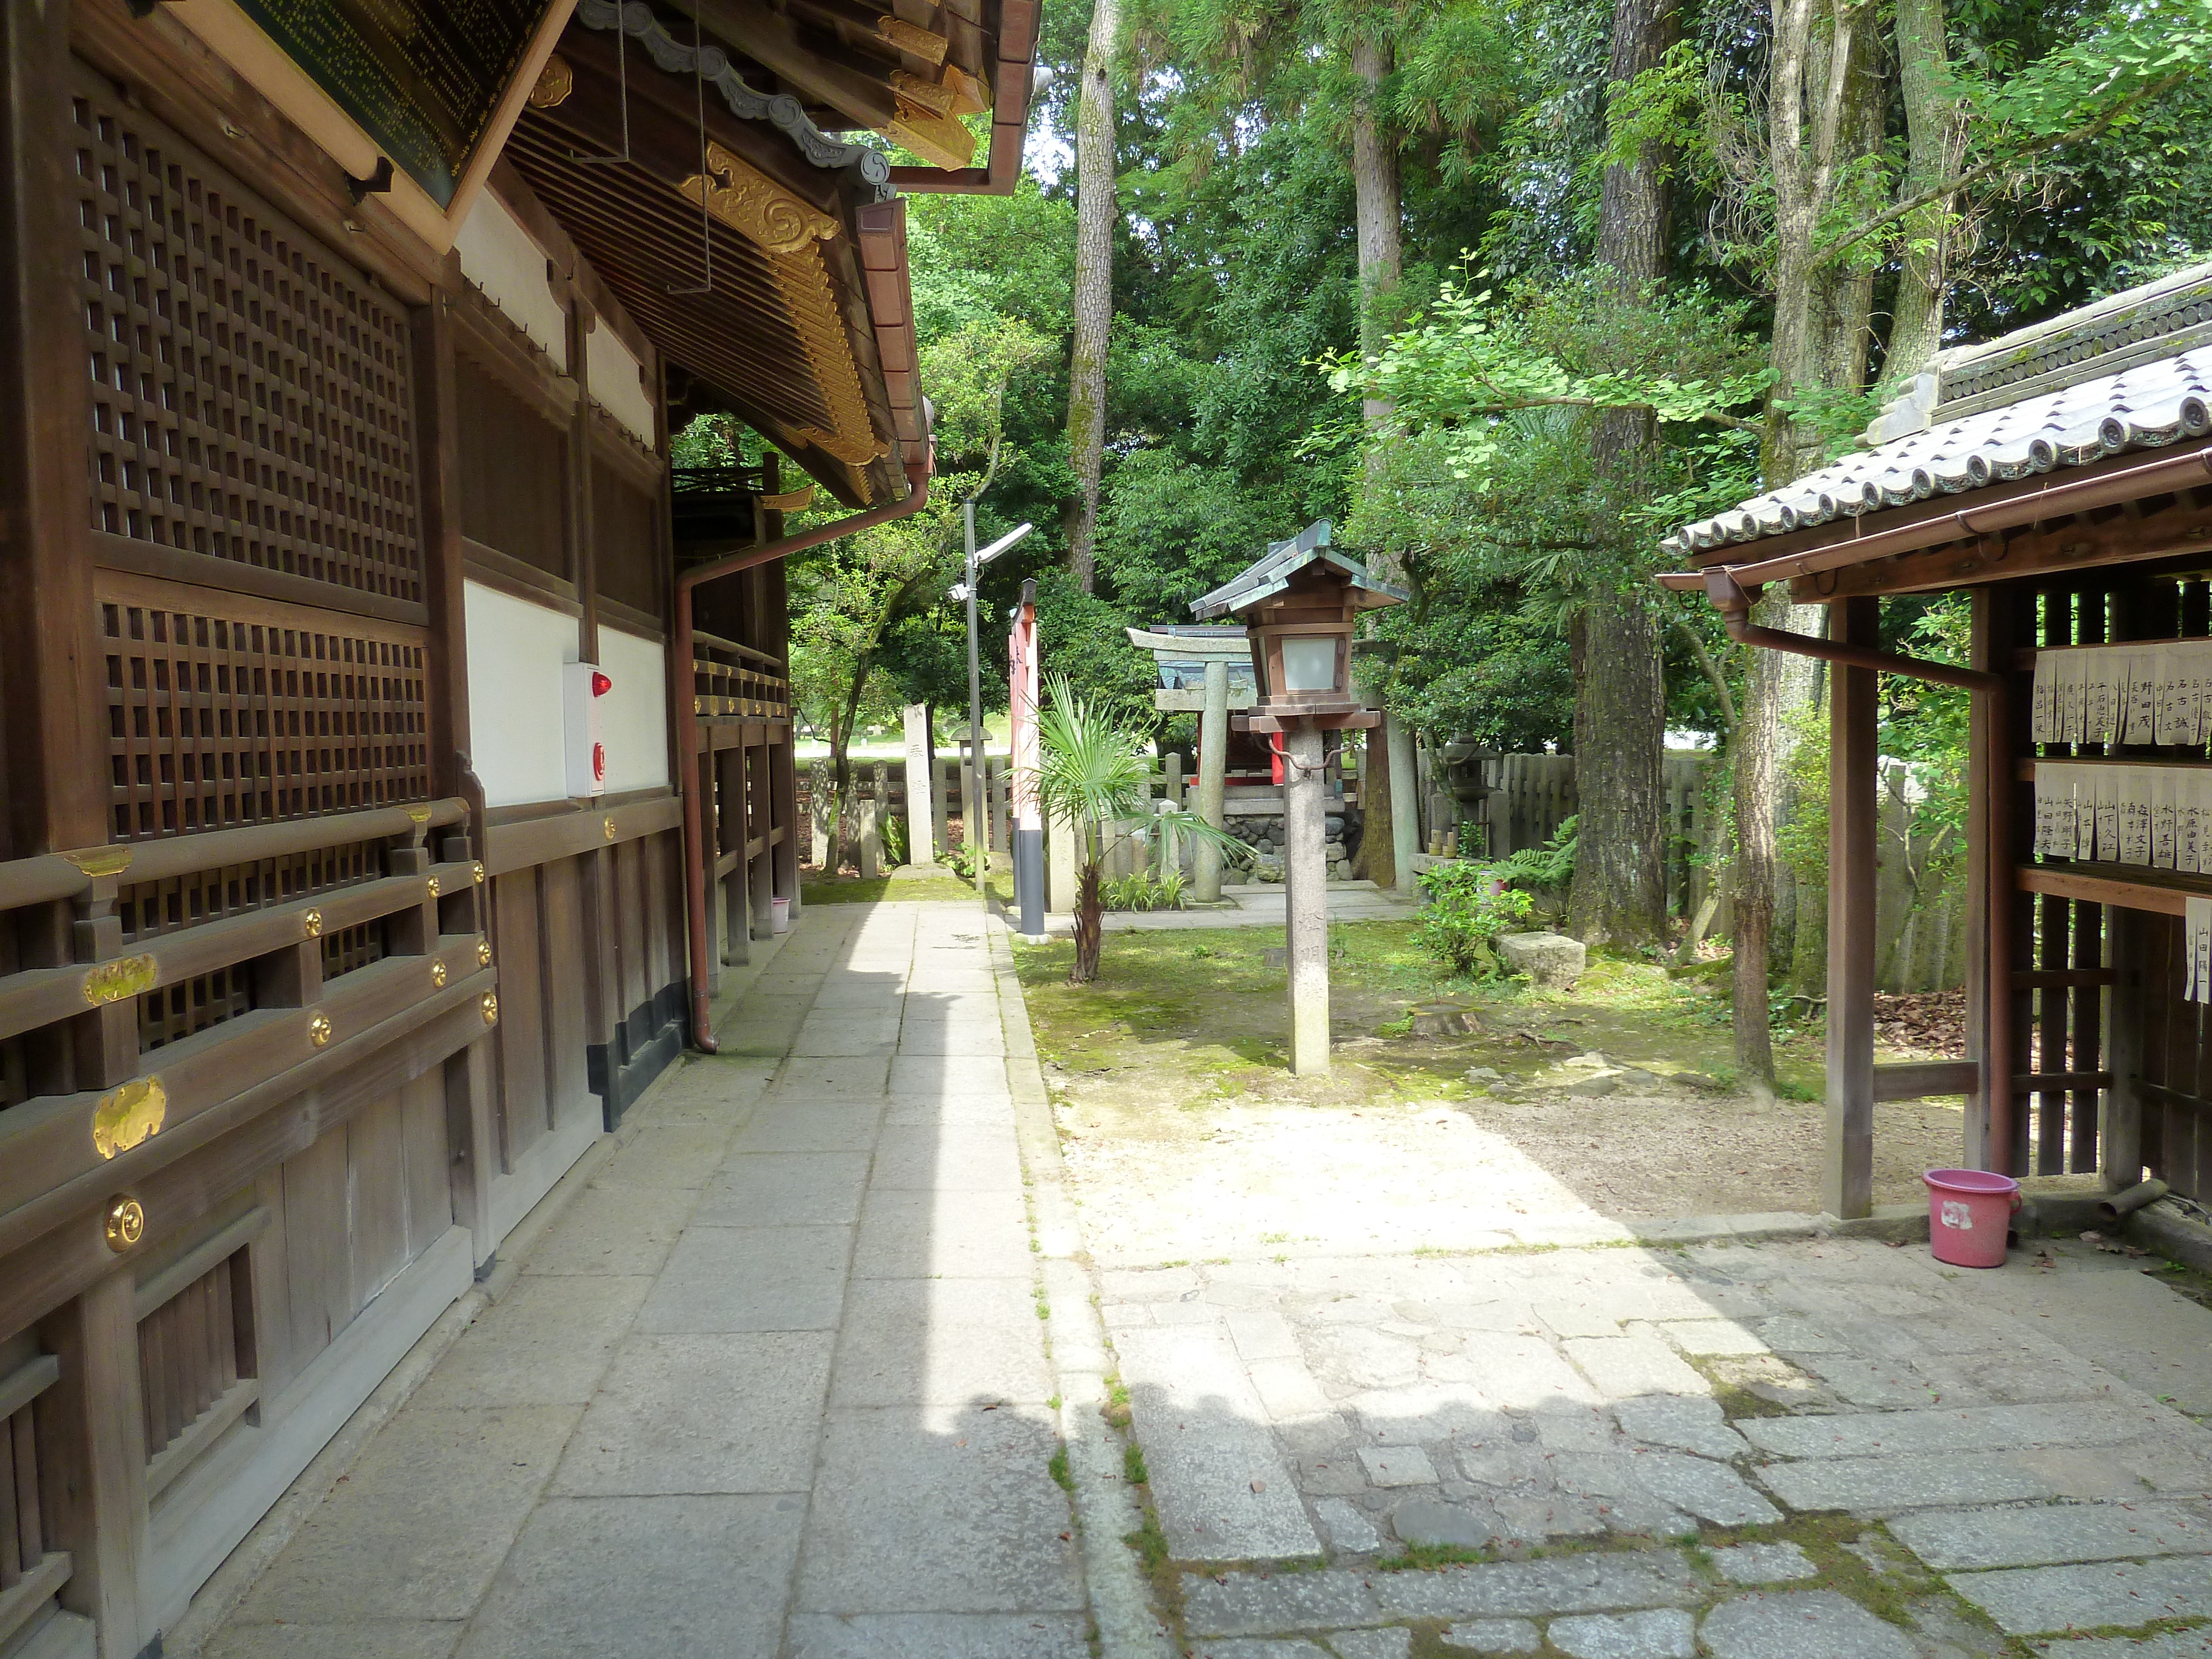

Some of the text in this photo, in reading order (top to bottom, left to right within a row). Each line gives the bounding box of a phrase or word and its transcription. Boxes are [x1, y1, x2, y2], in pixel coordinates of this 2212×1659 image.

[2137, 681, 2152, 728] 野田茂
[2173, 679, 2189, 729] 名古誠
[2040, 796, 2053, 850] 山田隆夫
[2102, 800, 2117, 852] 山下久江
[2185, 806, 2200, 866] 水原由美子
[2198, 927, 2208, 984] 山田陽一
